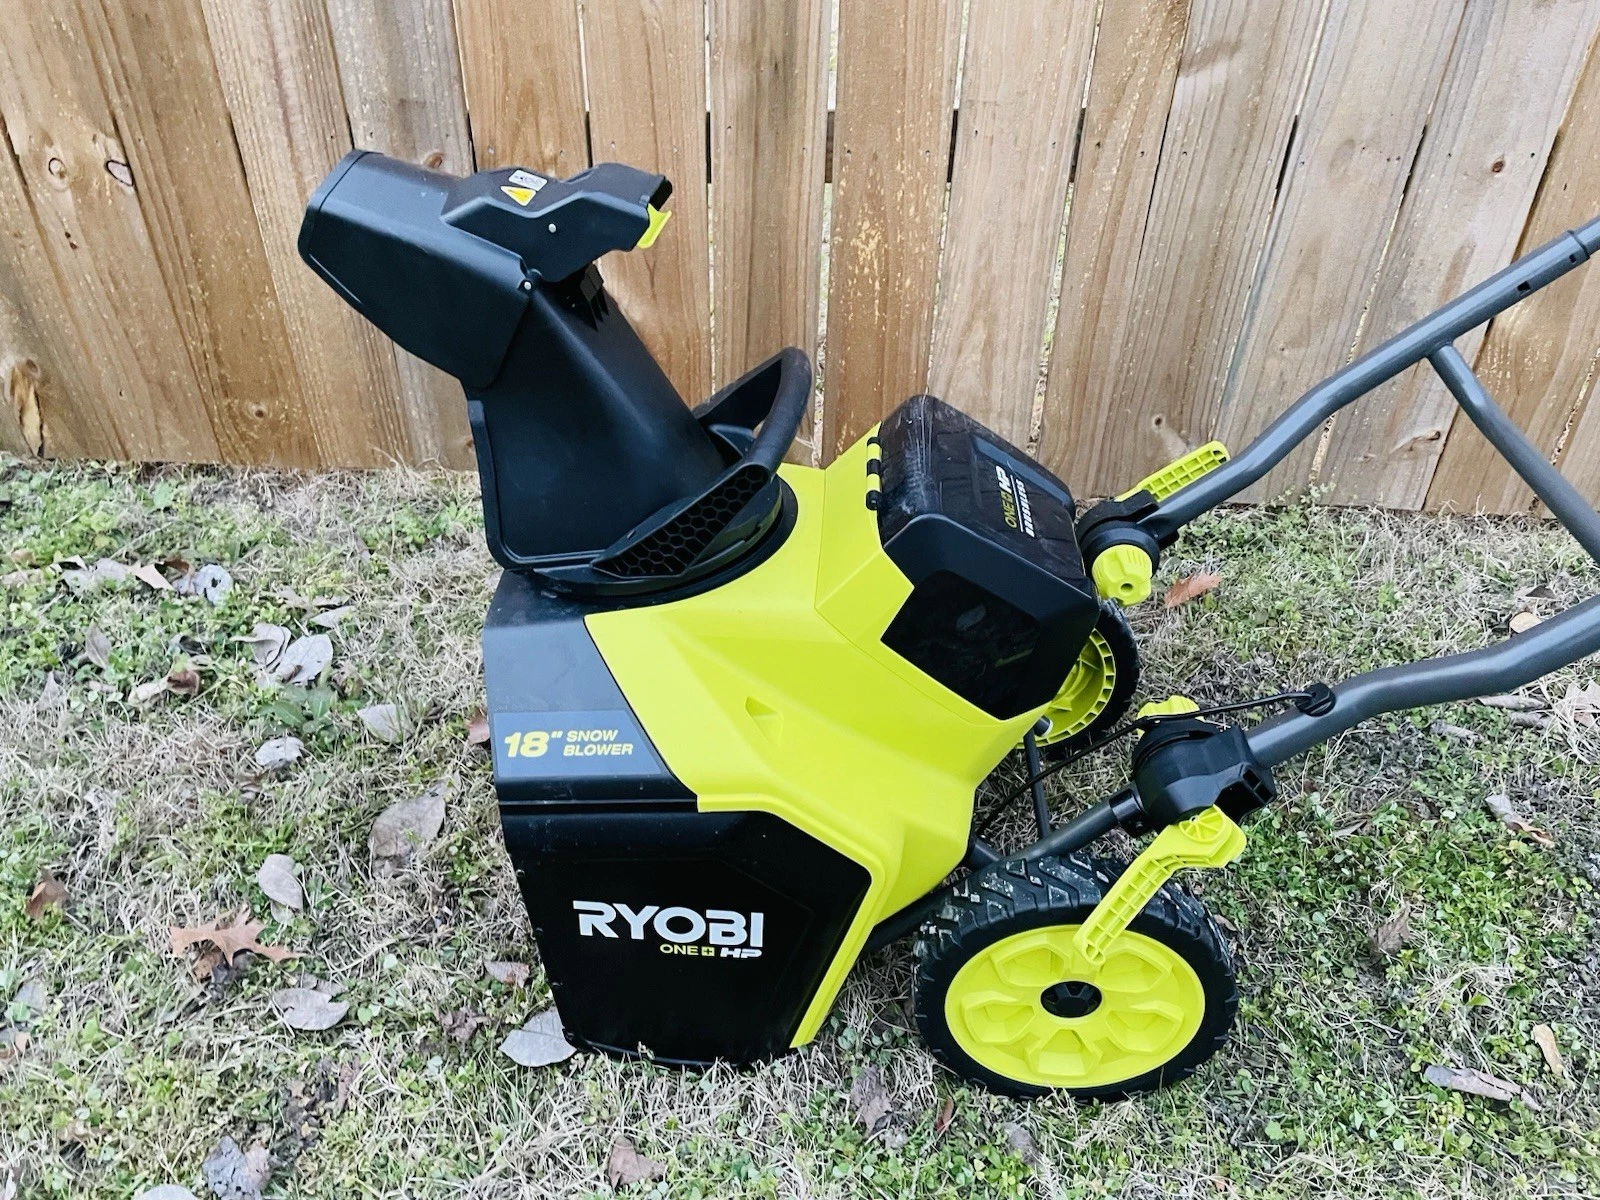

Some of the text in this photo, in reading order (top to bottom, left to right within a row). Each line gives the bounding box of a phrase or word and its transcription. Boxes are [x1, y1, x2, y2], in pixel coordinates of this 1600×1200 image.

[996, 465, 1012, 494] HP
[1016, 478, 1035, 538] BRUSHLESS
[566, 729, 619, 743] SNOW
[563, 743, 634, 757] BLOWER
[573, 900, 764, 948] RYOBI
[720, 947, 763, 959] HP
